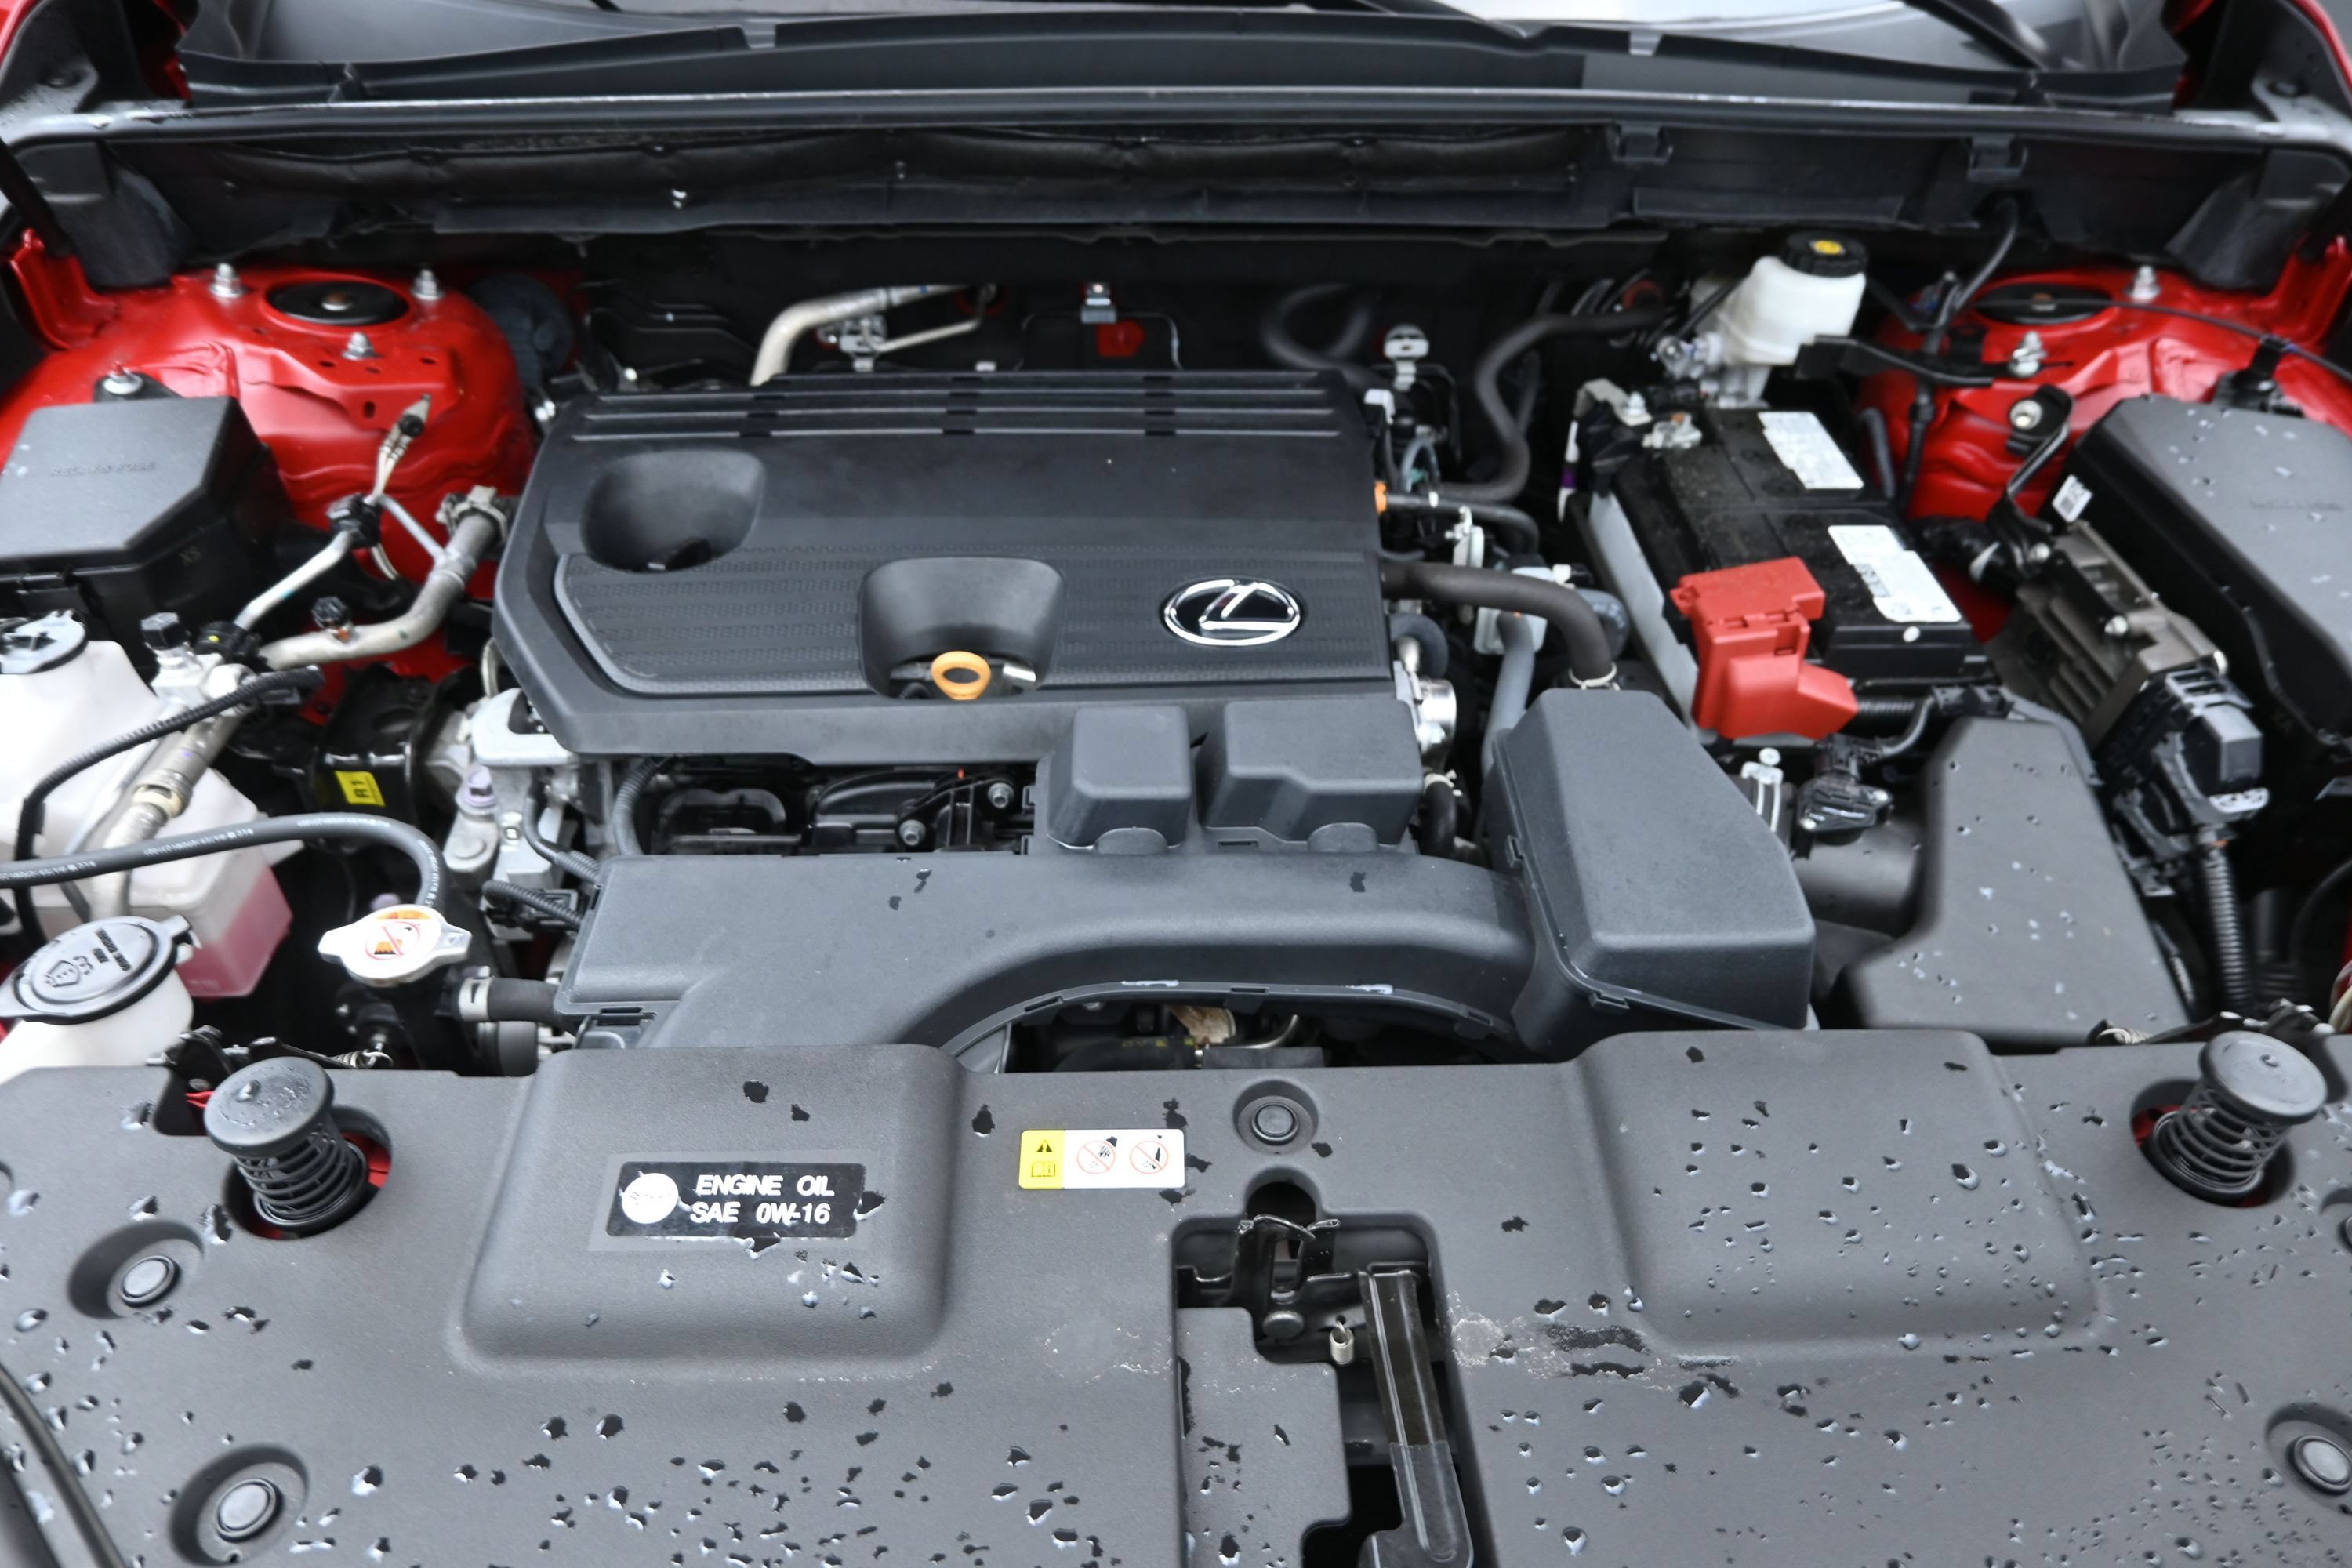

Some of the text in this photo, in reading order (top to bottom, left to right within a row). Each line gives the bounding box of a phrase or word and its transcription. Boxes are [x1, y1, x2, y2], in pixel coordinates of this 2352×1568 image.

[695, 1174, 834, 1196] ENGINE OIL
[690, 1202, 831, 1225] SAE 0W-16
